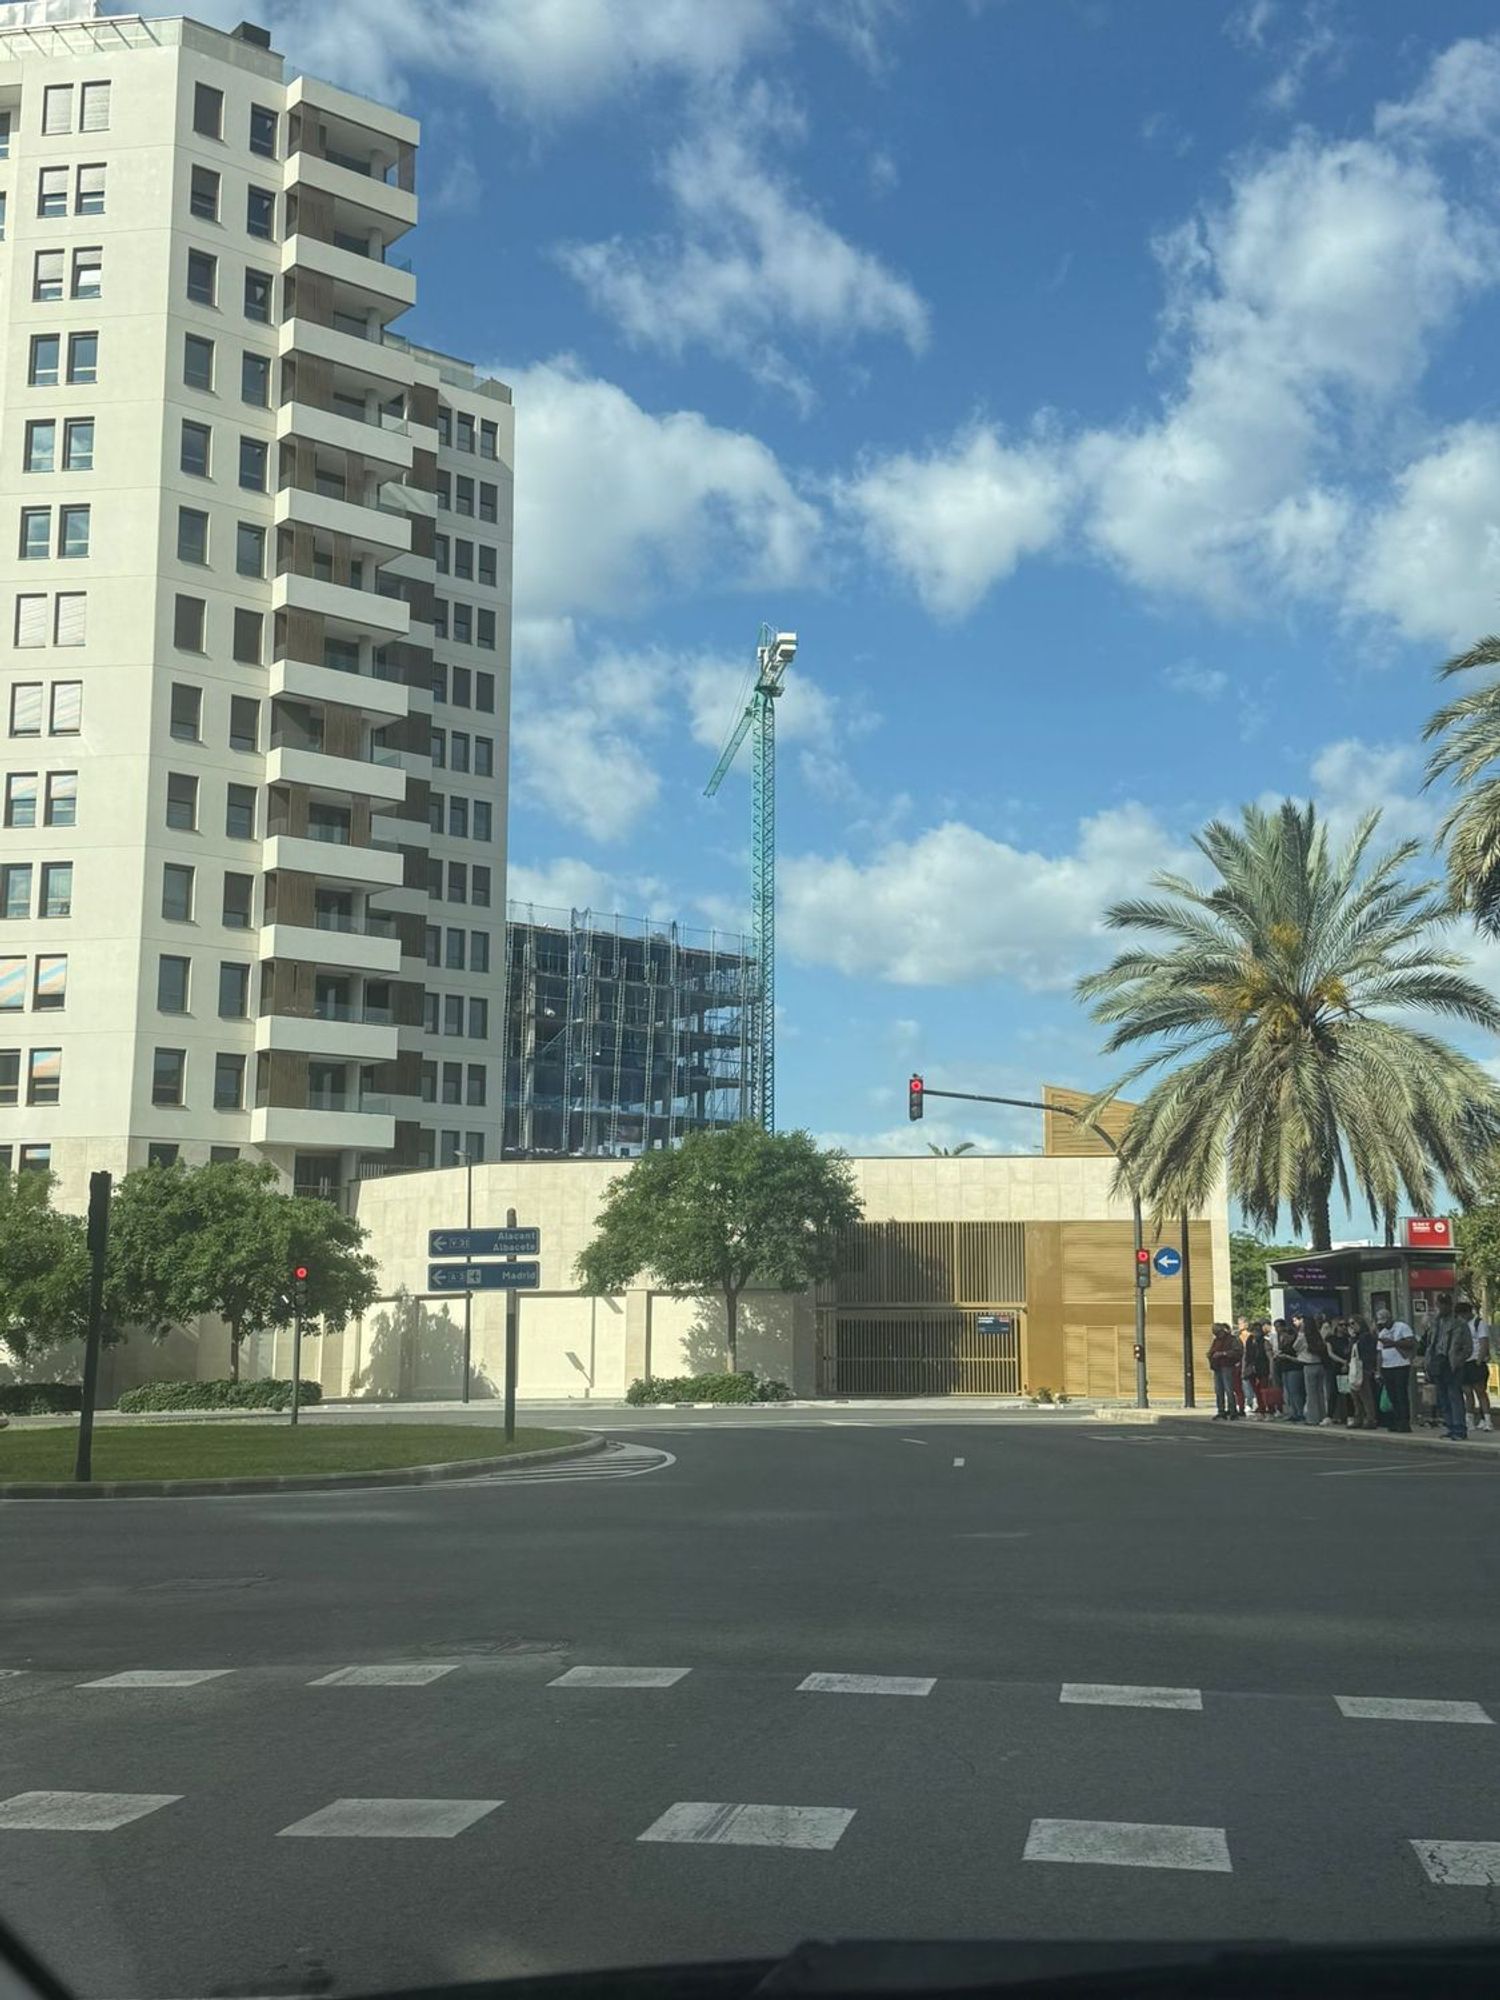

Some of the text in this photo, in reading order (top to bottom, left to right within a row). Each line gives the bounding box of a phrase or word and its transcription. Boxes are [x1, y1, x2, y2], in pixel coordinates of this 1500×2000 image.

[498, 1232, 535, 1240] Alacant
[493, 1243, 535, 1251] Albacete
[502, 1271, 536, 1280] Madrid
